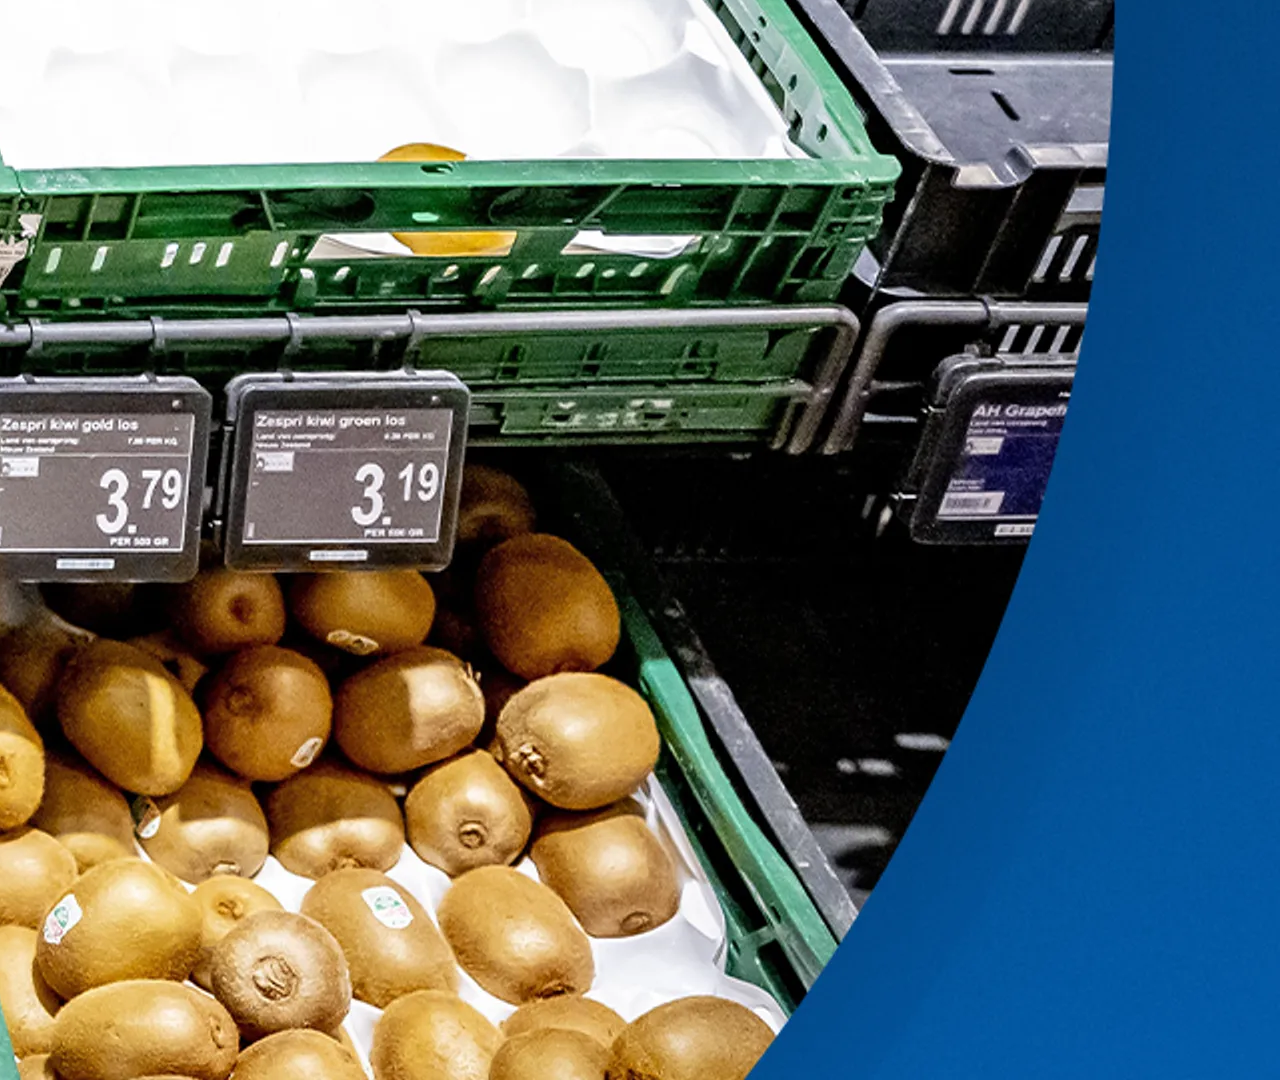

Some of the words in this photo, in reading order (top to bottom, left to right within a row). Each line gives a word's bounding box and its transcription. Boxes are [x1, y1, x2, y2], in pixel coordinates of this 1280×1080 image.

[973, 404, 1000, 416] AH
[1, 418, 47, 432] Zespri
[50, 419, 78, 430] kiwi
[82, 419, 113, 432] gold
[118, 418, 138, 430] los
[256, 416, 302, 428] Zespri
[306, 416, 335, 426] kiwi
[340, 416, 381, 428] groen
[386, 415, 405, 425] los
